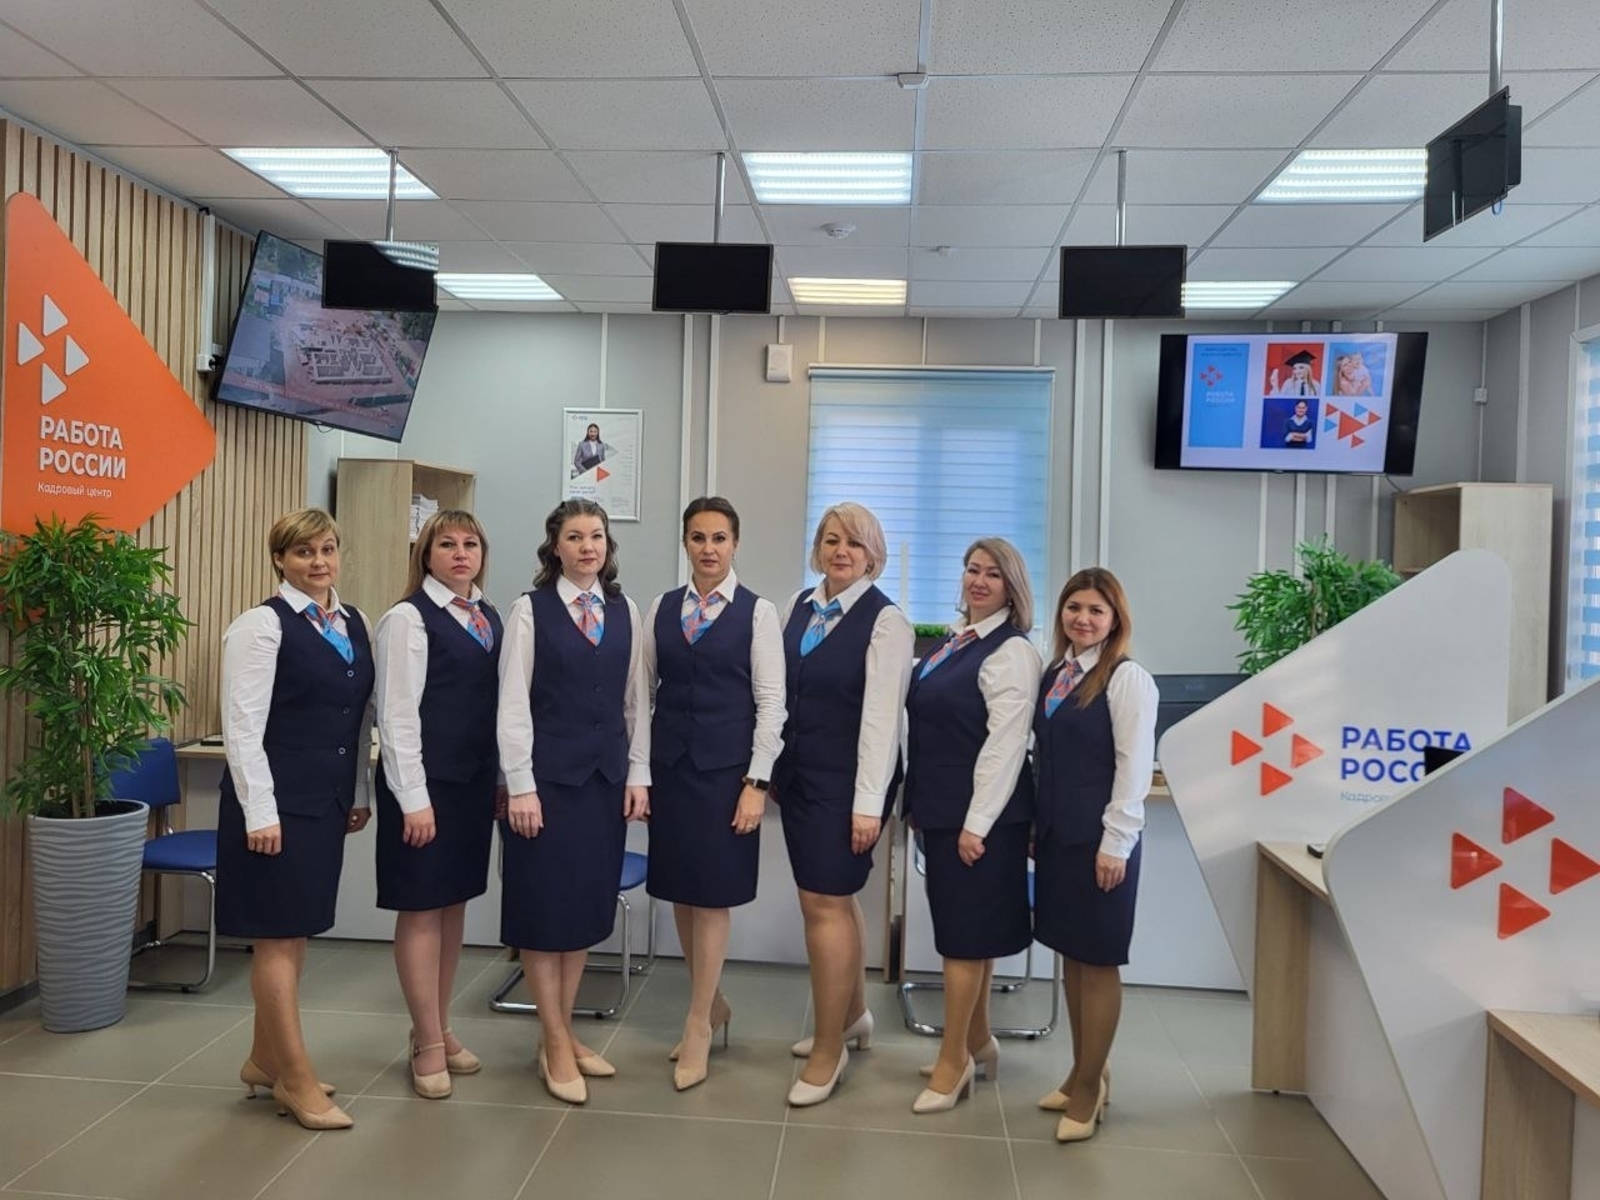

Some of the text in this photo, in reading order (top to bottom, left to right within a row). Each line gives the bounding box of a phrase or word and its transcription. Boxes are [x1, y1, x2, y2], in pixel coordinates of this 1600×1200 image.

[40, 415, 123, 450] РАБОТА
[39, 446, 126, 479] РОССИИ
[37, 482, 112, 498] Кадровый центр
[1341, 726, 1472, 752] РАБОТА
